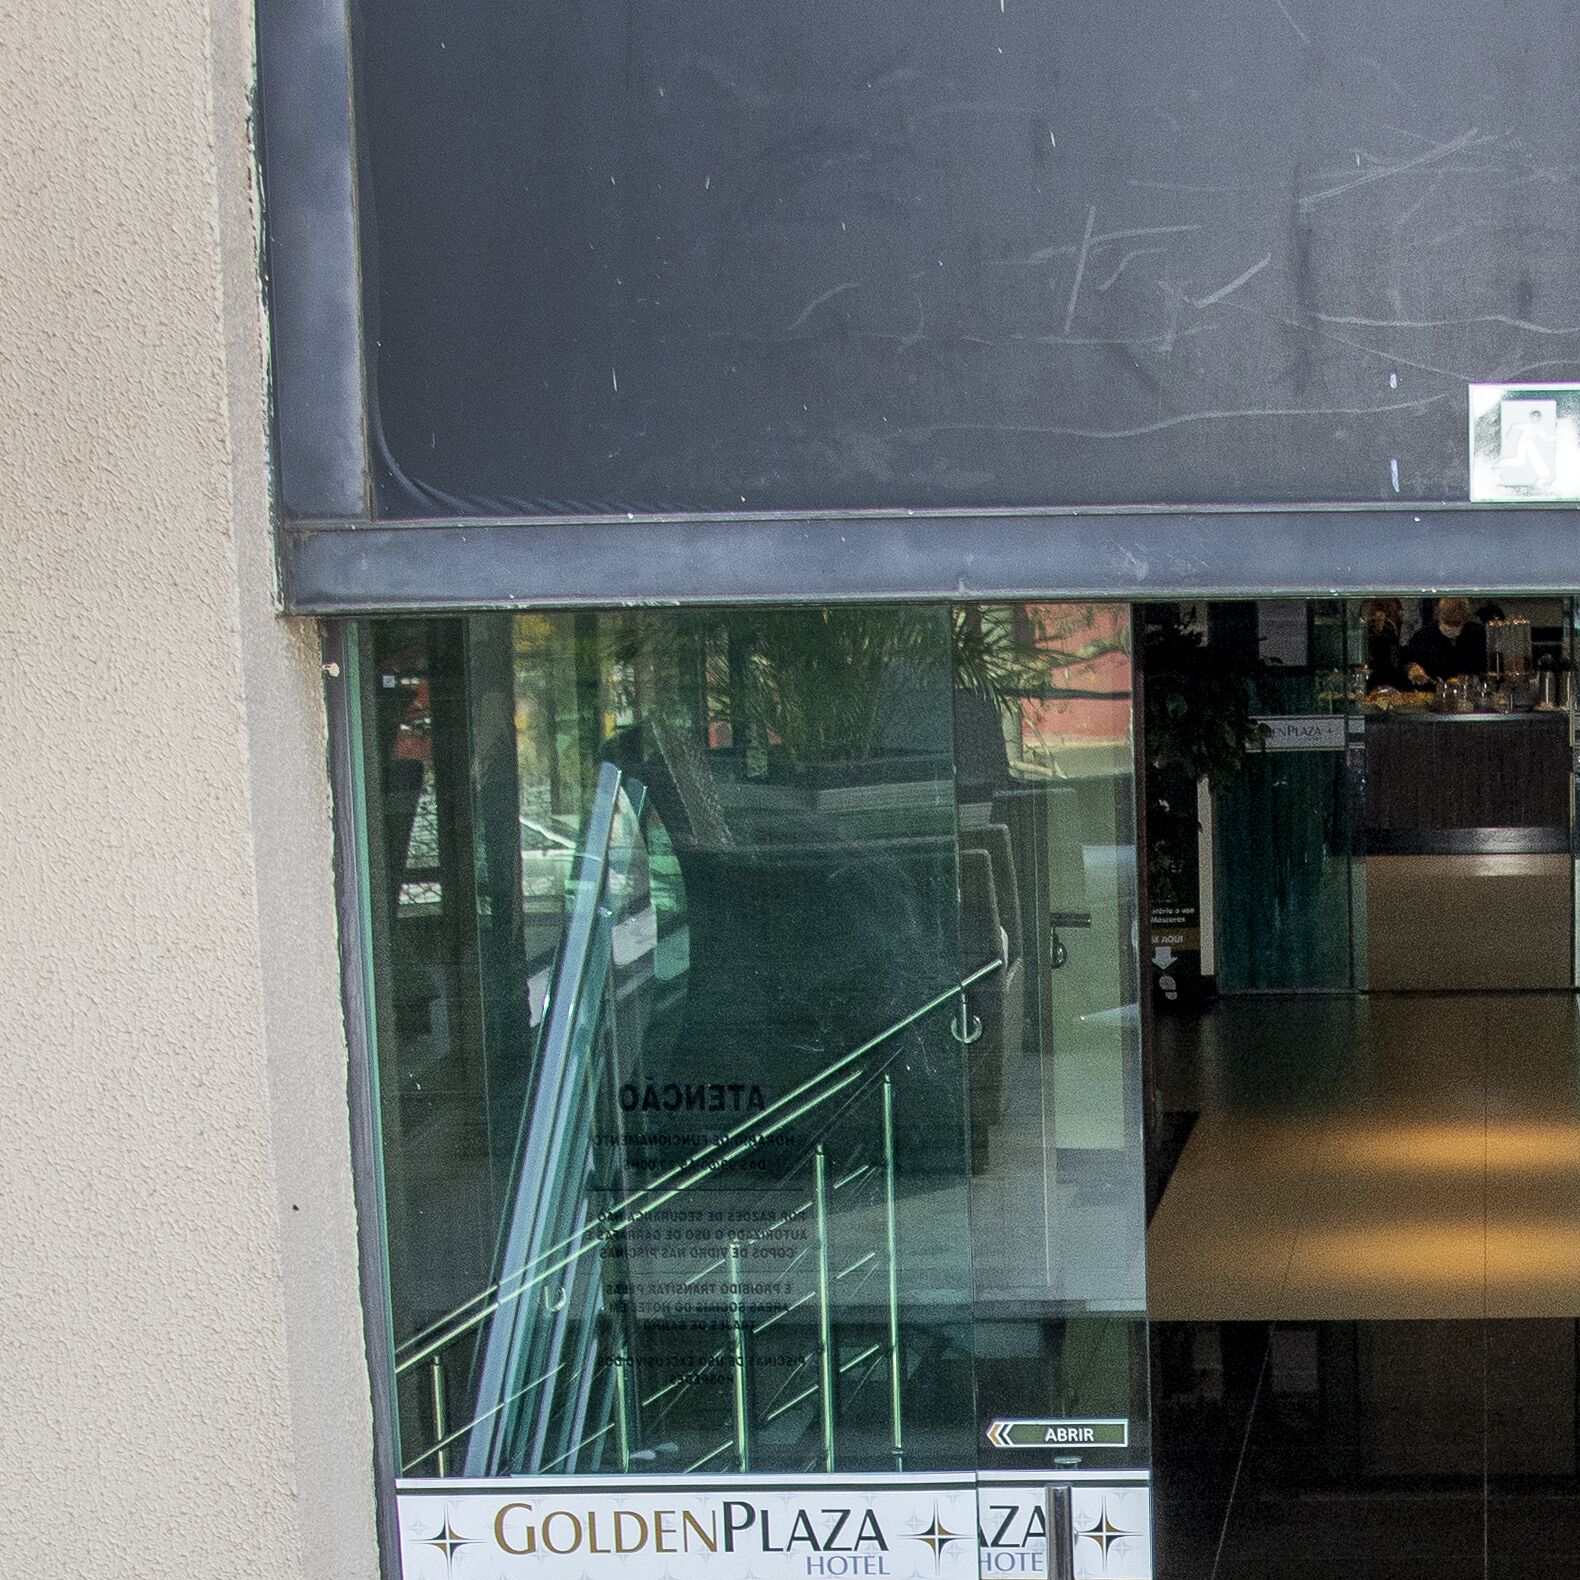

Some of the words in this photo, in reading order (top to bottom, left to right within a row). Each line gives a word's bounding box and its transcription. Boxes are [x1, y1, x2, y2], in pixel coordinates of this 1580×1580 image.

[1044, 1427, 1094, 1442] ABRIR
[980, 1505, 1047, 1548] ZA
[806, 1555, 890, 1576] HOTEL
[981, 1552, 1044, 1572] HOTE
